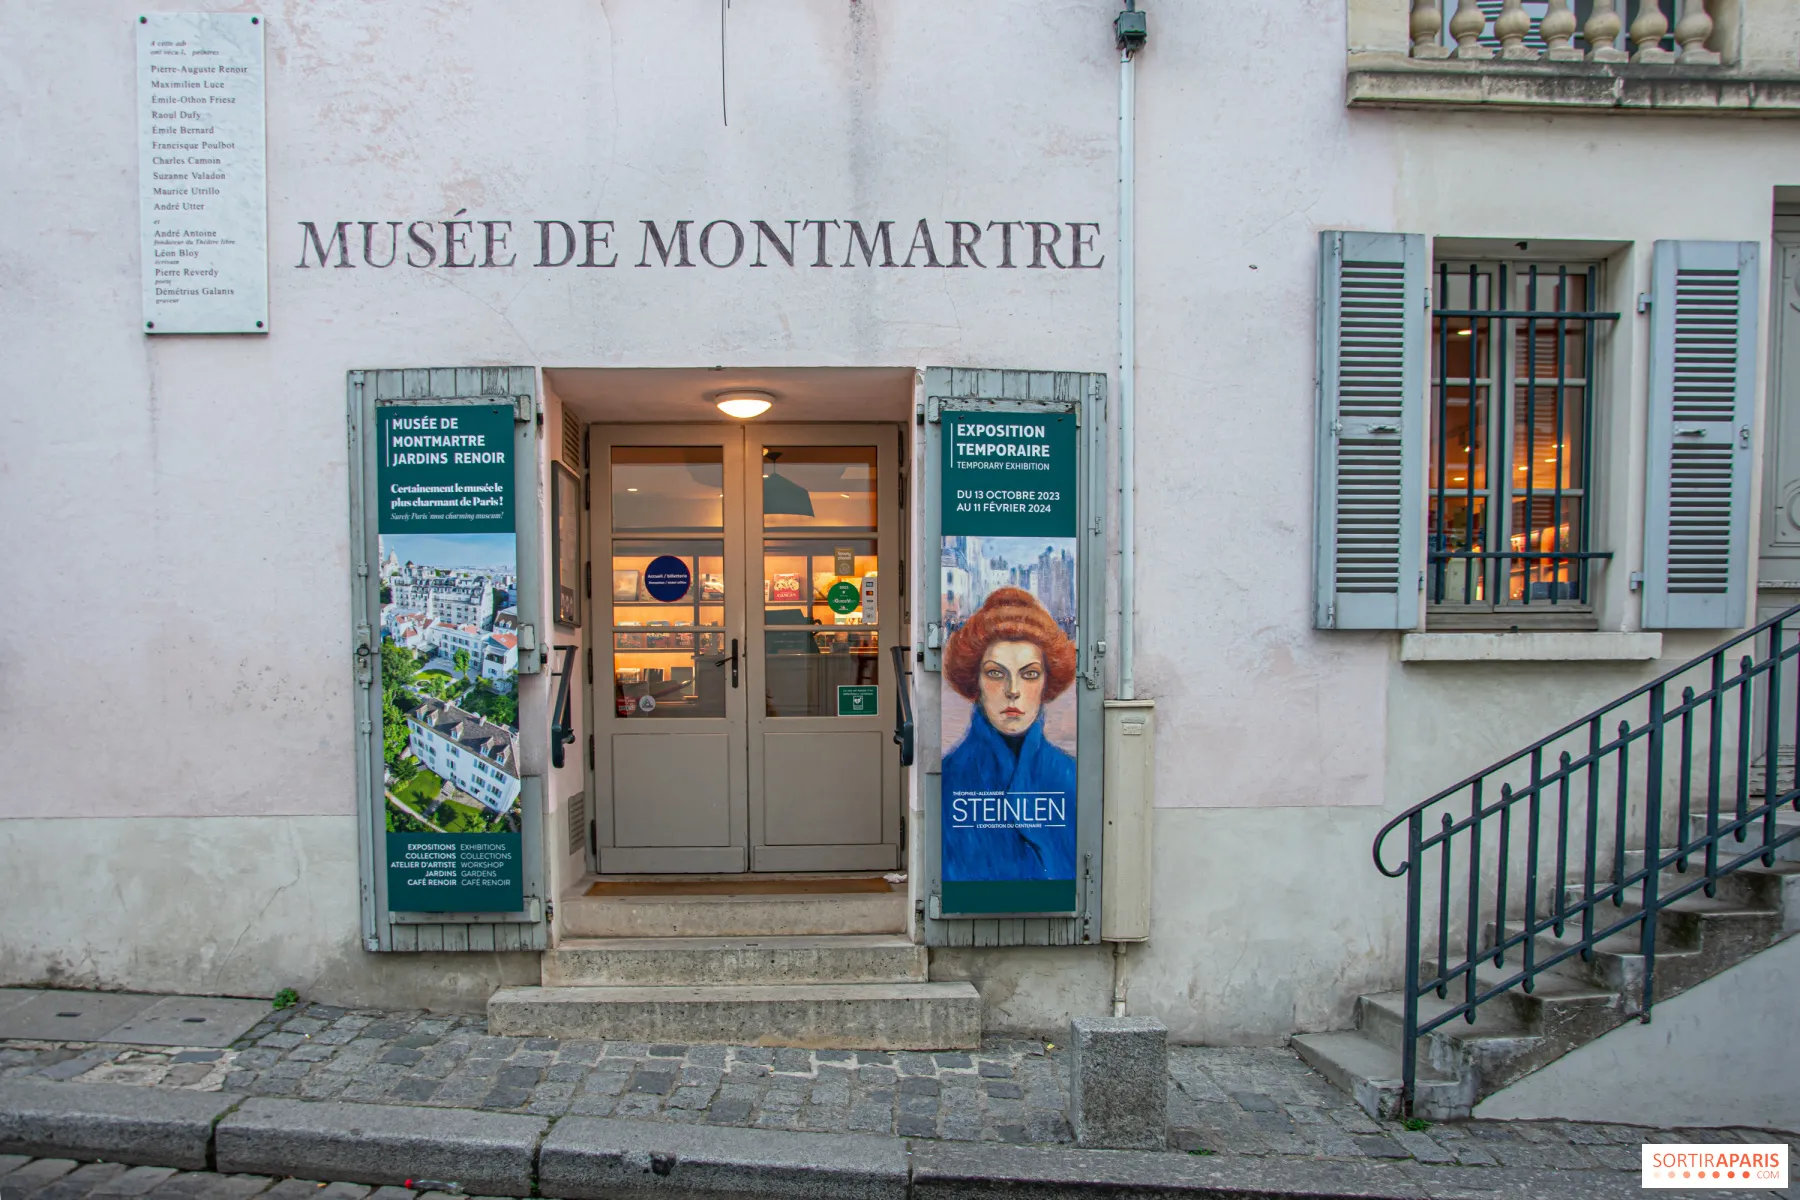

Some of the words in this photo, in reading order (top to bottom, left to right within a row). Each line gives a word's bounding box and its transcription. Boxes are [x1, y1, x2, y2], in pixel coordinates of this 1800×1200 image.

[151, 65, 216, 75] Pierre-Auguste
[152, 94, 206, 104] Émile-Othon
[210, 96, 236, 104] Friesz
[152, 111, 176, 119] Raoul
[180, 111, 201, 120] Dufy
[152, 125, 177, 134] Émile
[180, 126, 214, 134] Bernard
[152, 141, 199, 151] Francisque
[202, 141, 235, 149] Poulbot
[153, 172, 188, 180] Suzanne
[192, 172, 225, 180] Valadon
[192, 187, 220, 195] Utrillo
[154, 229, 179, 237] André
[294, 208, 517, 270] MUSÉE
[532, 219, 619, 269] DE
[636, 217, 1106, 269] MONTMARTRE
[155, 249, 175, 257] Léon
[179, 249, 199, 258] Bloy
[184, 269, 219, 277] Reverdy
[392, 416, 437, 430] MUSÉE
[440, 418, 458, 429] DE
[957, 424, 1044, 438] EXPOSITION
[392, 435, 485, 447] MONTMARTRE
[957, 444, 1050, 457] TEMPORAIRE
[392, 453, 448, 466] JARDINS
[455, 452, 505, 464] RENOIR
[957, 462, 1004, 470] TEMPORARY
[390, 484, 454, 494] Certainement
[454, 483, 463, 492] le
[464, 483, 493, 493] musée
[493, 483, 503, 492] le
[957, 490, 972, 499] DU
[975, 491, 984, 499] 13
[986, 491, 1035, 500] OCTOBRE
[1038, 492, 1060, 500] 2023
[391, 498, 411, 509] plus
[412, 497, 458, 506] charmant
[460, 497, 471, 506] de
[473, 497, 498, 506] Paris
[956, 503, 971, 512] AU
[974, 504, 980, 512] 11
[984, 501, 1026, 512] FÉVRIER
[1028, 504, 1051, 512] 2024
[390, 512, 410, 521] Surely
[445, 512, 474, 521] charming
[953, 798, 1065, 822] STEINLEN
[408, 878, 426, 886] CAFÉ
[462, 878, 480, 886] CAFÉ
